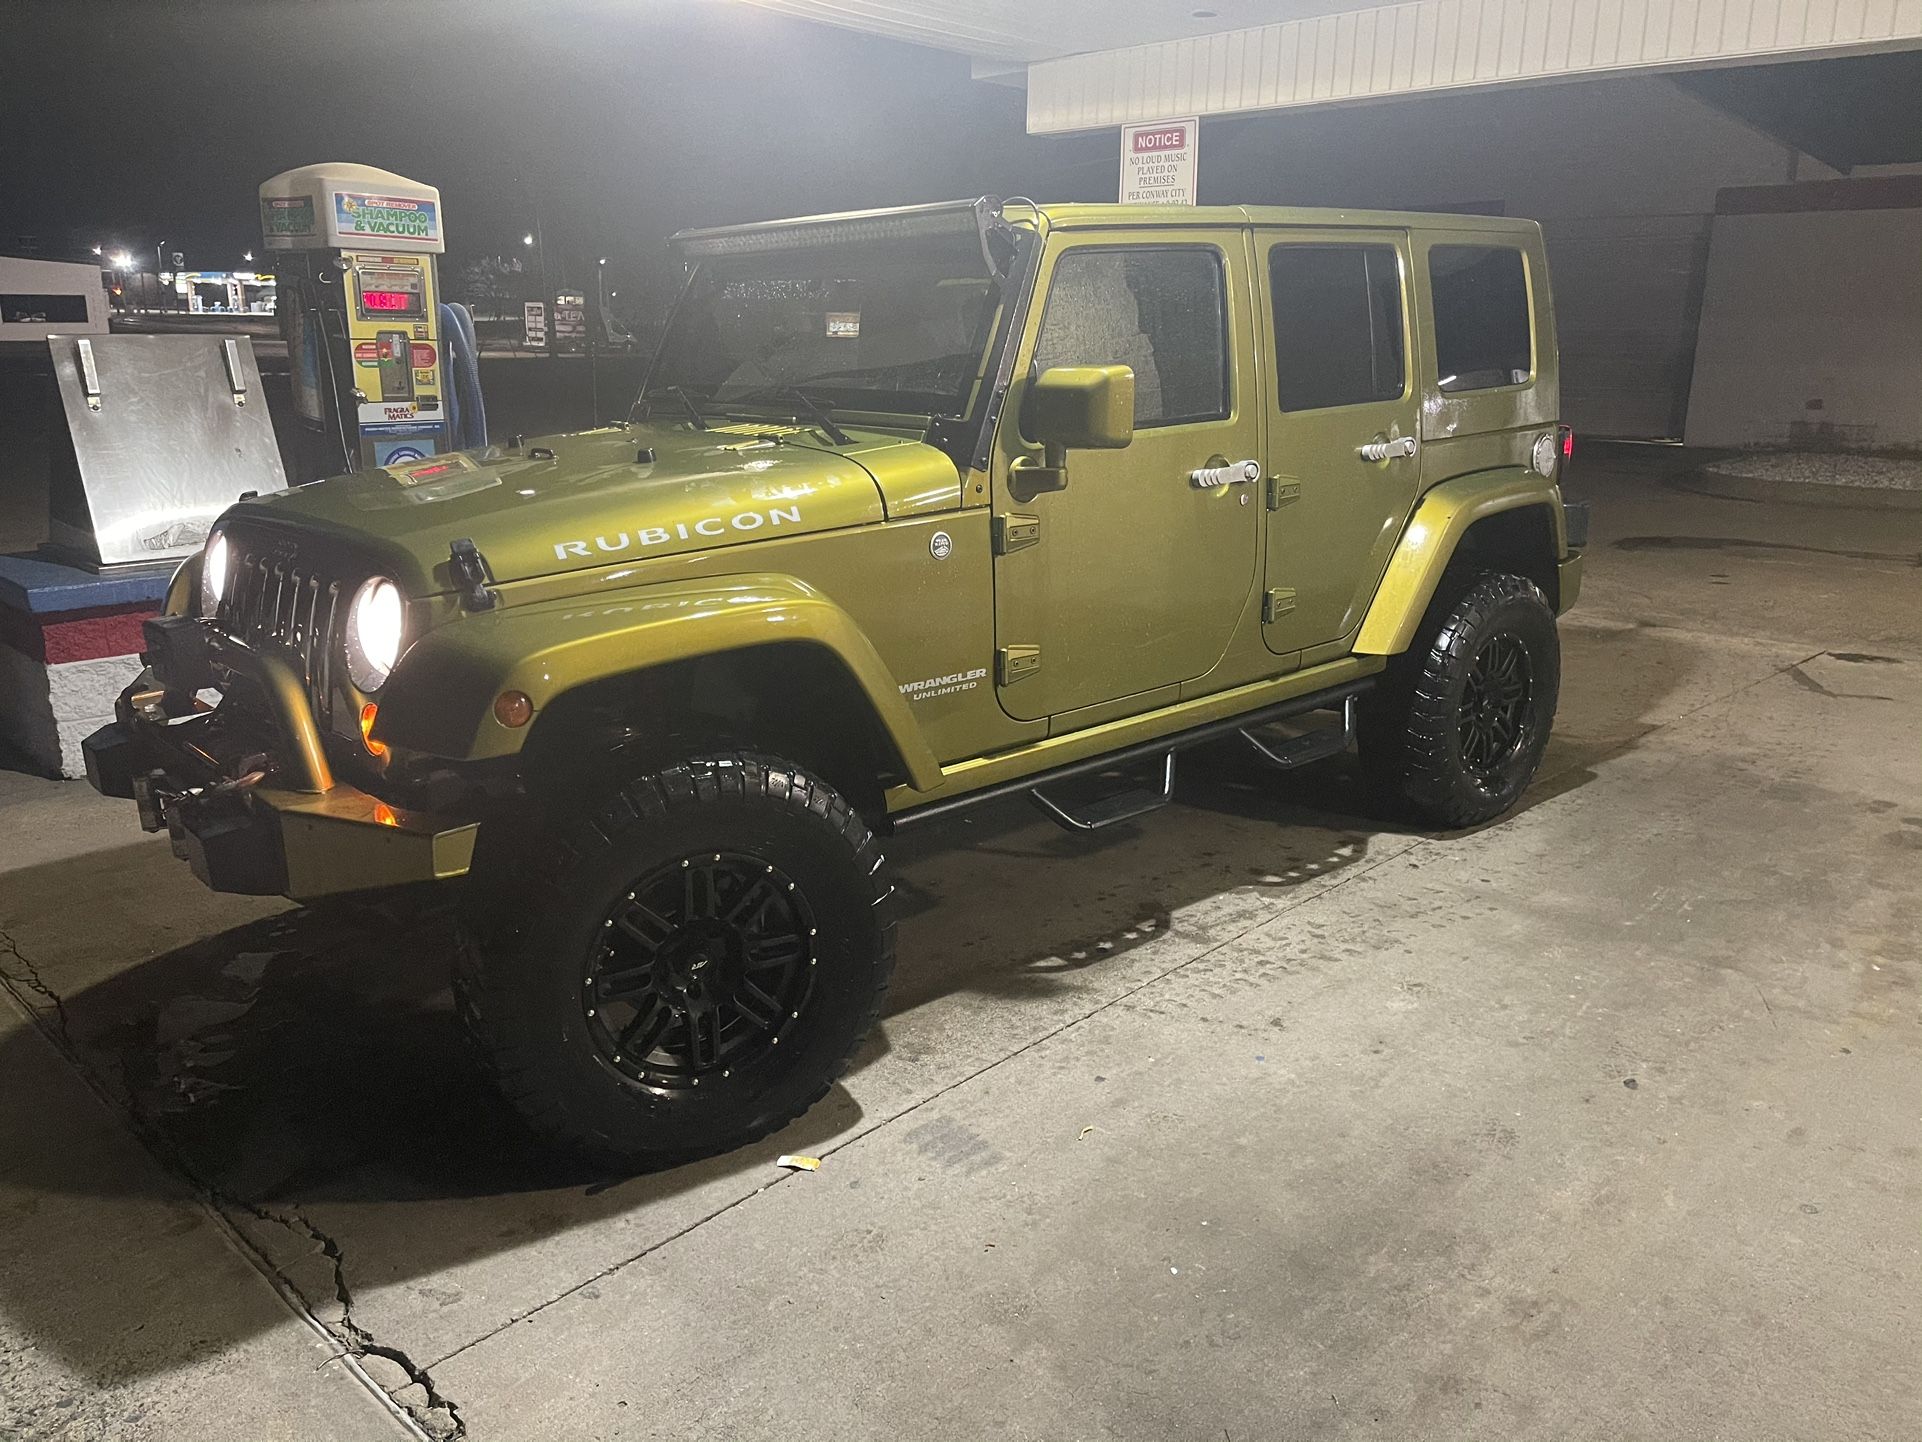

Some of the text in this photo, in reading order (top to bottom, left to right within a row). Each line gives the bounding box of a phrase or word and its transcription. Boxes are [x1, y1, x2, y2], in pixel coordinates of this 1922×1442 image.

[1138, 133, 1180, 148] NOTICE
[1130, 153, 1187, 166] NO LOUD MUSIC
[1137, 164, 1177, 175] PLAYED ON
[1139, 175, 1175, 185] PREMISES
[1128, 188, 1185, 200] PER CONWAY CITY
[385, 201, 416, 209] REMOVER
[351, 207, 428, 224] SHAMPOO
[354, 219, 429, 236] & VACUUM
[553, 505, 801, 560] RUBICON
[898, 668, 987, 694] WRANGLER
[913, 681, 977, 700] UNLIMITED
